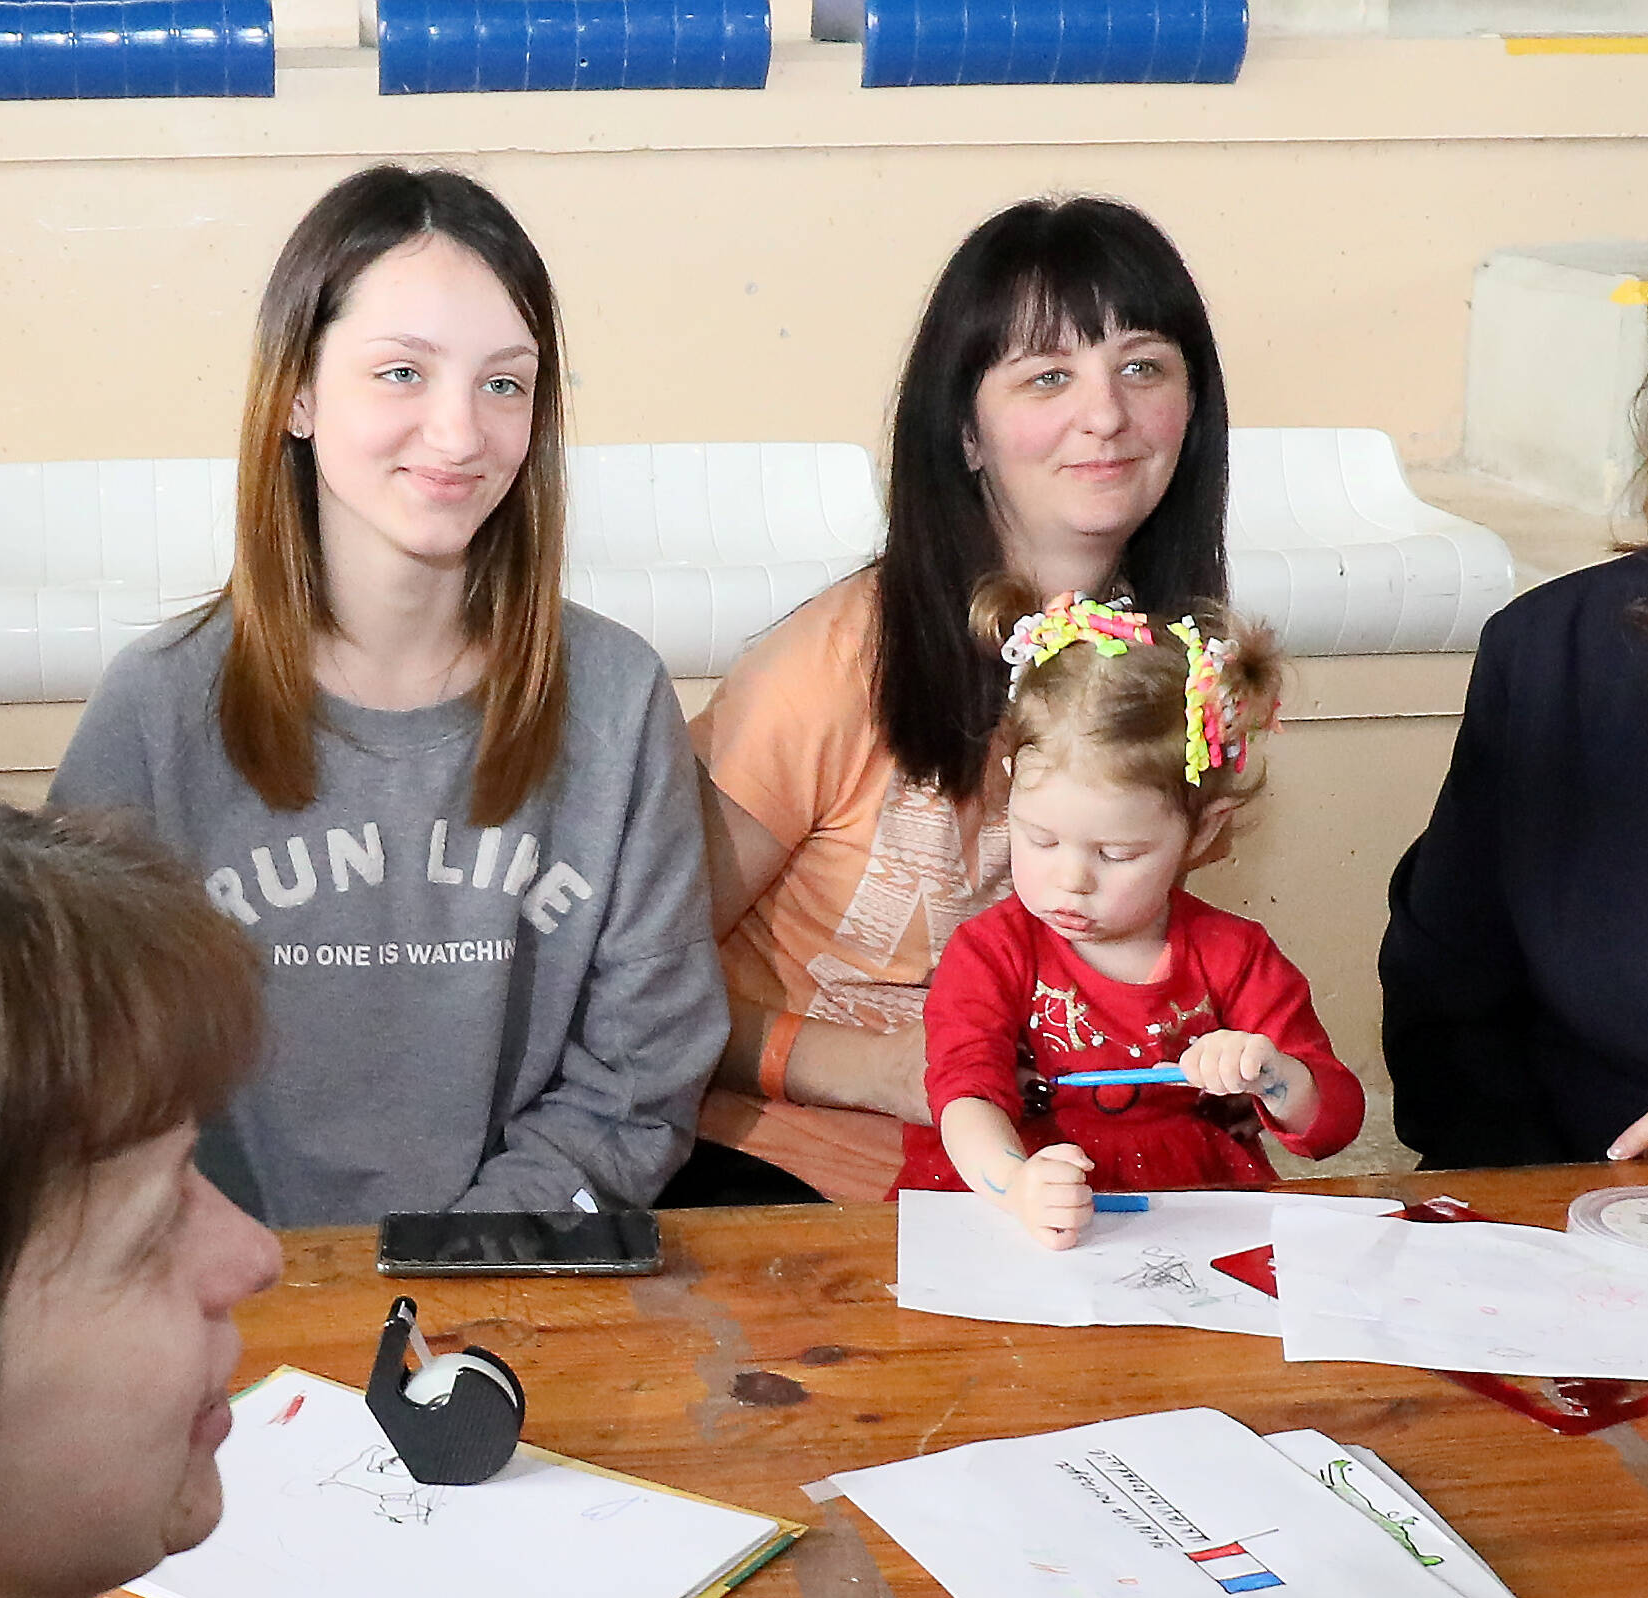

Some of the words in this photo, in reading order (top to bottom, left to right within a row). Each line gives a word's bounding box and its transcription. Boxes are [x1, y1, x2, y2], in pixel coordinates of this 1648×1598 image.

[205, 820, 385, 926] RUN
[272, 943, 310, 967] NO
[316, 943, 372, 967] ONE
[379, 943, 400, 966] IS
[406, 940, 517, 965] WATCHIN
